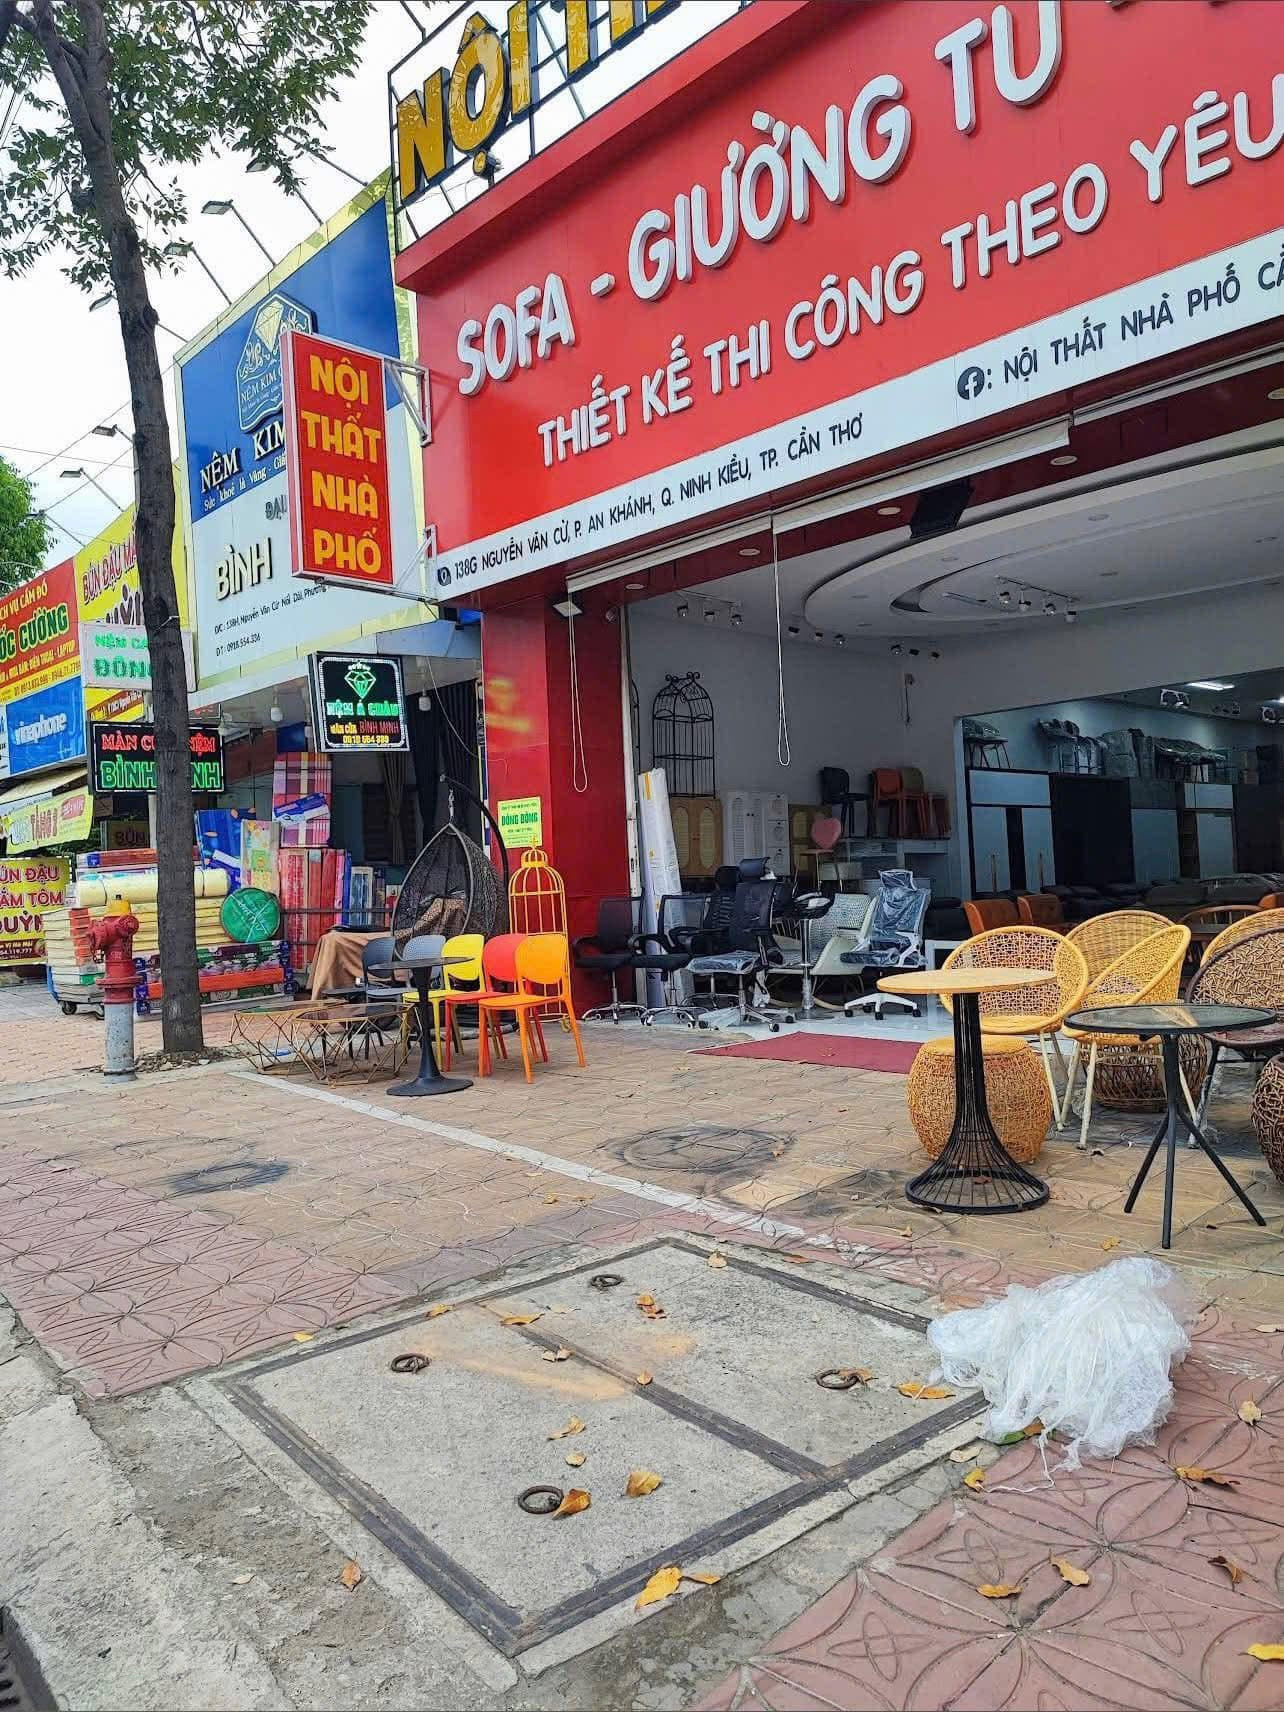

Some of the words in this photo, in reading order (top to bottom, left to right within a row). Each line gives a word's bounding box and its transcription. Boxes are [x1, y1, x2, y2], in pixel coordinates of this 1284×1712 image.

[396, 1, 537, 203] NỘI
[457, 273, 575, 397] SOFA
[628, 74, 912, 302] GIƯỜNG
[538, 374, 631, 467] THIẾT
[641, 334, 694, 425] KẾ
[703, 319, 771, 395] THI
[784, 249, 924, 361] CÔNG
[940, 163, 1109, 290] THEO
[1129, 73, 1284, 203] YÊU
[1003, 346, 1038, 384] NỘI
[1050, 315, 1107, 366] THẤT
[1120, 292, 1174, 341] NHÀ
[1187, 262, 1241, 317] PHỐ
[309, 355, 369, 408] NỘI
[301, 409, 382, 463] THẤT
[200, 448, 241, 494] NỆM
[311, 470, 379, 519] NHÀ
[455, 556, 478, 580] 138G
[527, 531, 549, 554] VĂN
[588, 513, 604, 534] AN
[609, 493, 656, 526] KHÁNH,
[661, 487, 675, 507] Q.
[680, 471, 712, 501] NINH
[759, 447, 779, 471] TP.
[787, 426, 820, 461] CẦN
[828, 412, 863, 446] THƠ
[215, 537, 273, 602] BÌNH
[313, 526, 381, 573] PHỐ
[18, 603, 69, 653] CƯỜNG
[101, 730, 138, 751] MÀN
[100, 754, 157, 789] BÌNH
[0, 864, 21, 884] ÚN
[25, 864, 59, 885] ĐẬU
[27, 889, 64, 908] TÔM
